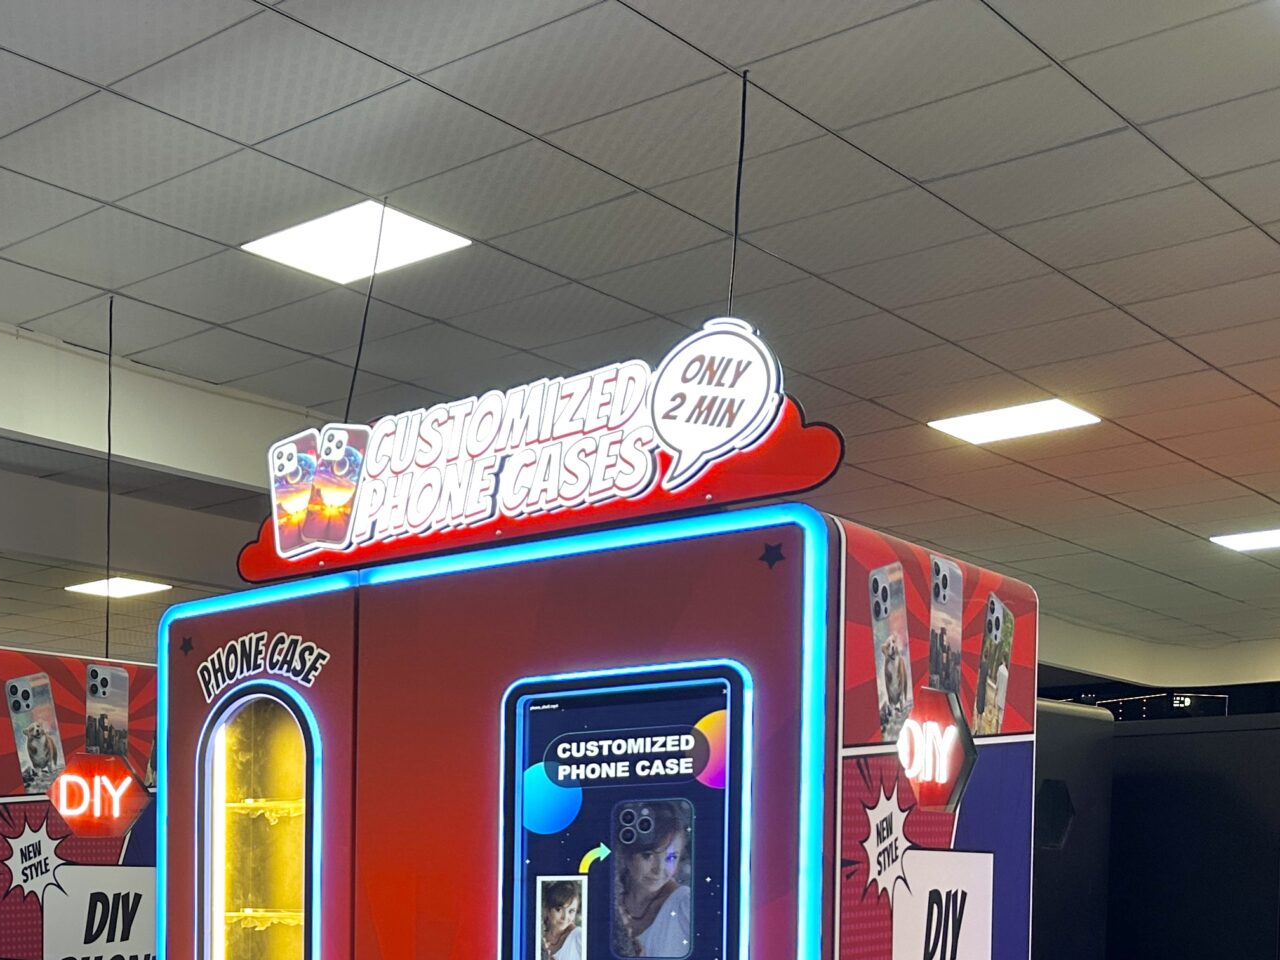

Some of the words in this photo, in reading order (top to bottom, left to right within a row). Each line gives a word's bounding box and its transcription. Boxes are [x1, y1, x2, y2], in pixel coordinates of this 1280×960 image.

[680, 355, 752, 388] ONLY
[366, 364, 649, 478] CUSTOMIZED
[662, 393, 684, 420] 2
[686, 397, 745, 428] MIN
[356, 454, 498, 538] PHONE
[499, 426, 653, 511] CASES
[198, 633, 266, 701] PHONE
[268, 634, 328, 686] CASE
[557, 734, 695, 758] CUSTOMIZED
[897, 719, 959, 784] DIY
[558, 761, 629, 780] PHONE
[635, 758, 693, 777] CASE
[58, 775, 132, 817] DIY
[876, 811, 894, 848] NEW
[20, 840, 41, 866] NEW
[22, 859, 50, 884] STYLE
[876, 837, 899, 876] STYLE
[84, 892, 142, 945] DIY
